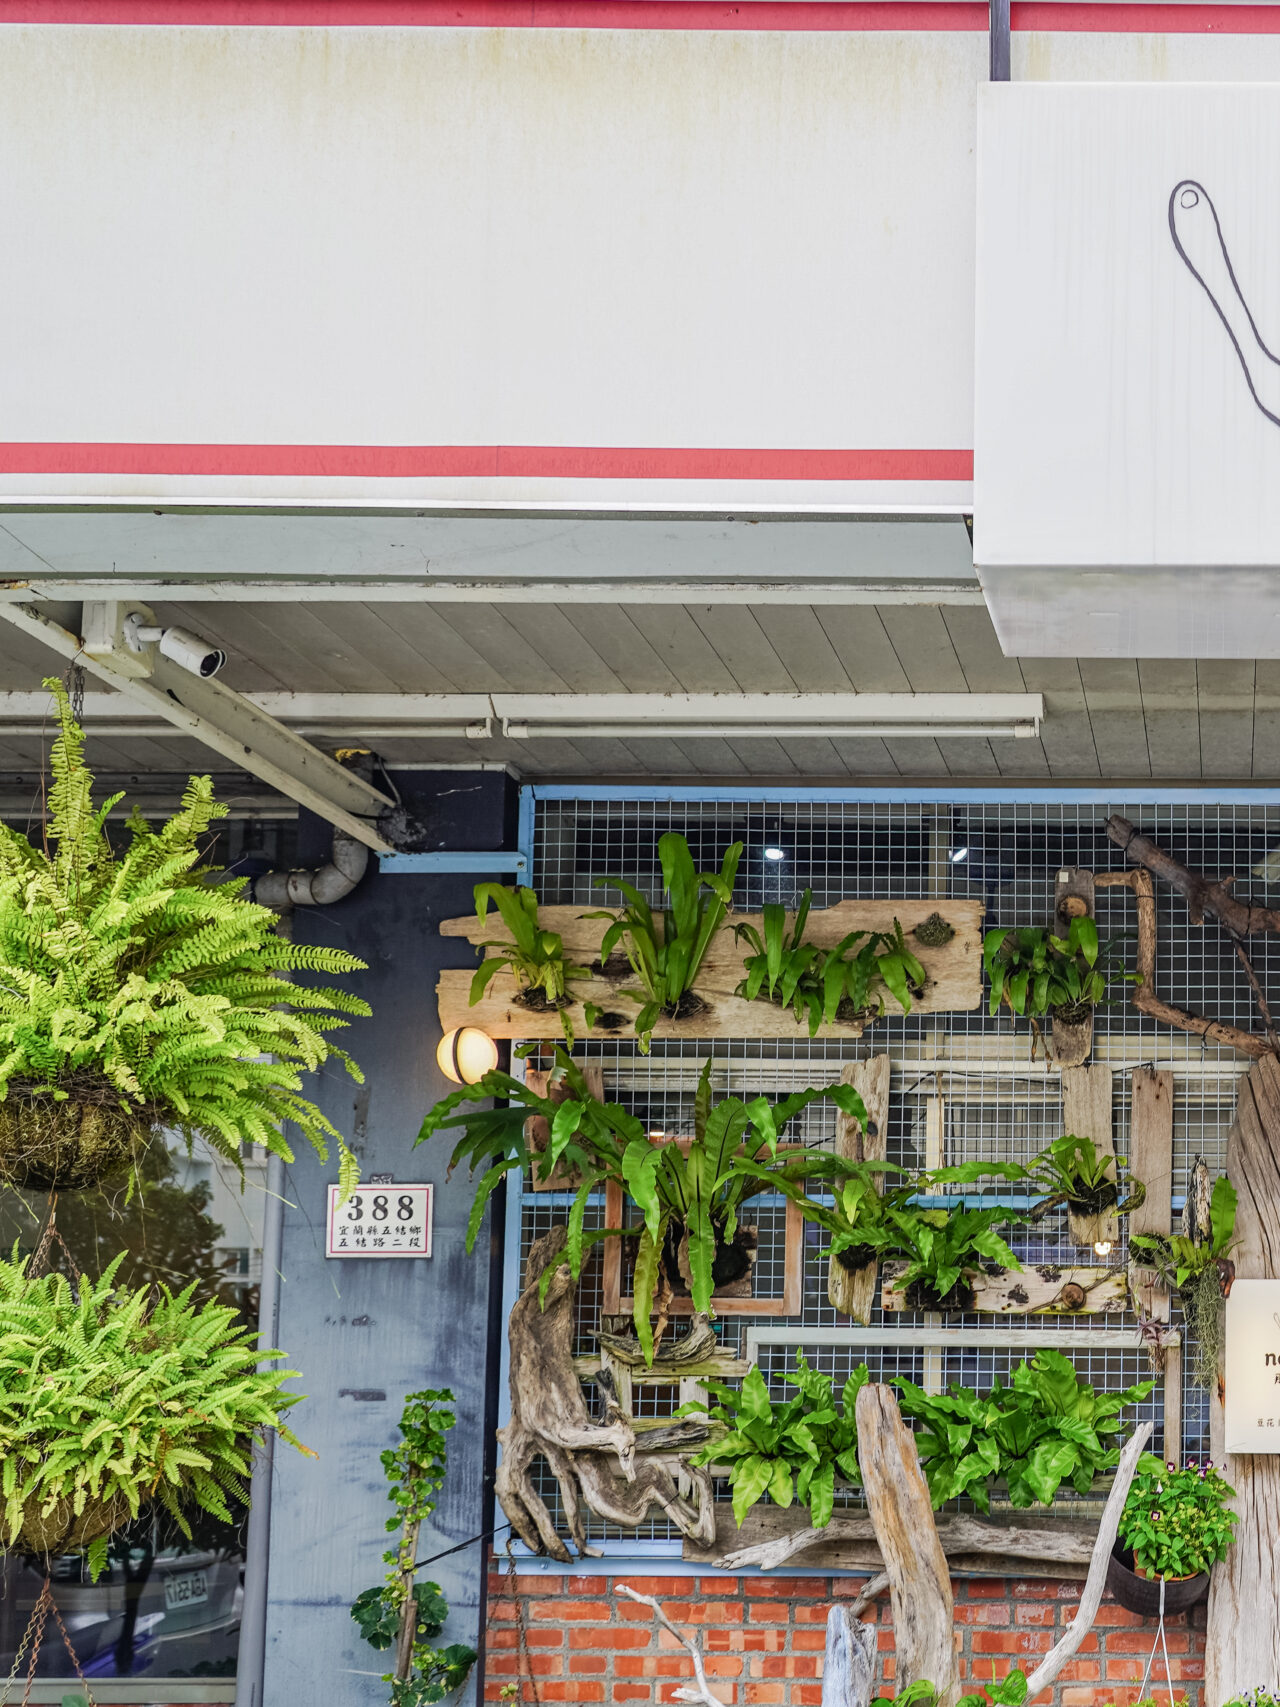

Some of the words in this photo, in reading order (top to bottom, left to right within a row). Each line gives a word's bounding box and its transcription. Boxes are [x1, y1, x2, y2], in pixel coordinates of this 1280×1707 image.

[347, 1195, 414, 1221] 388
[338, 1237, 421, 1248] 五結路二段
